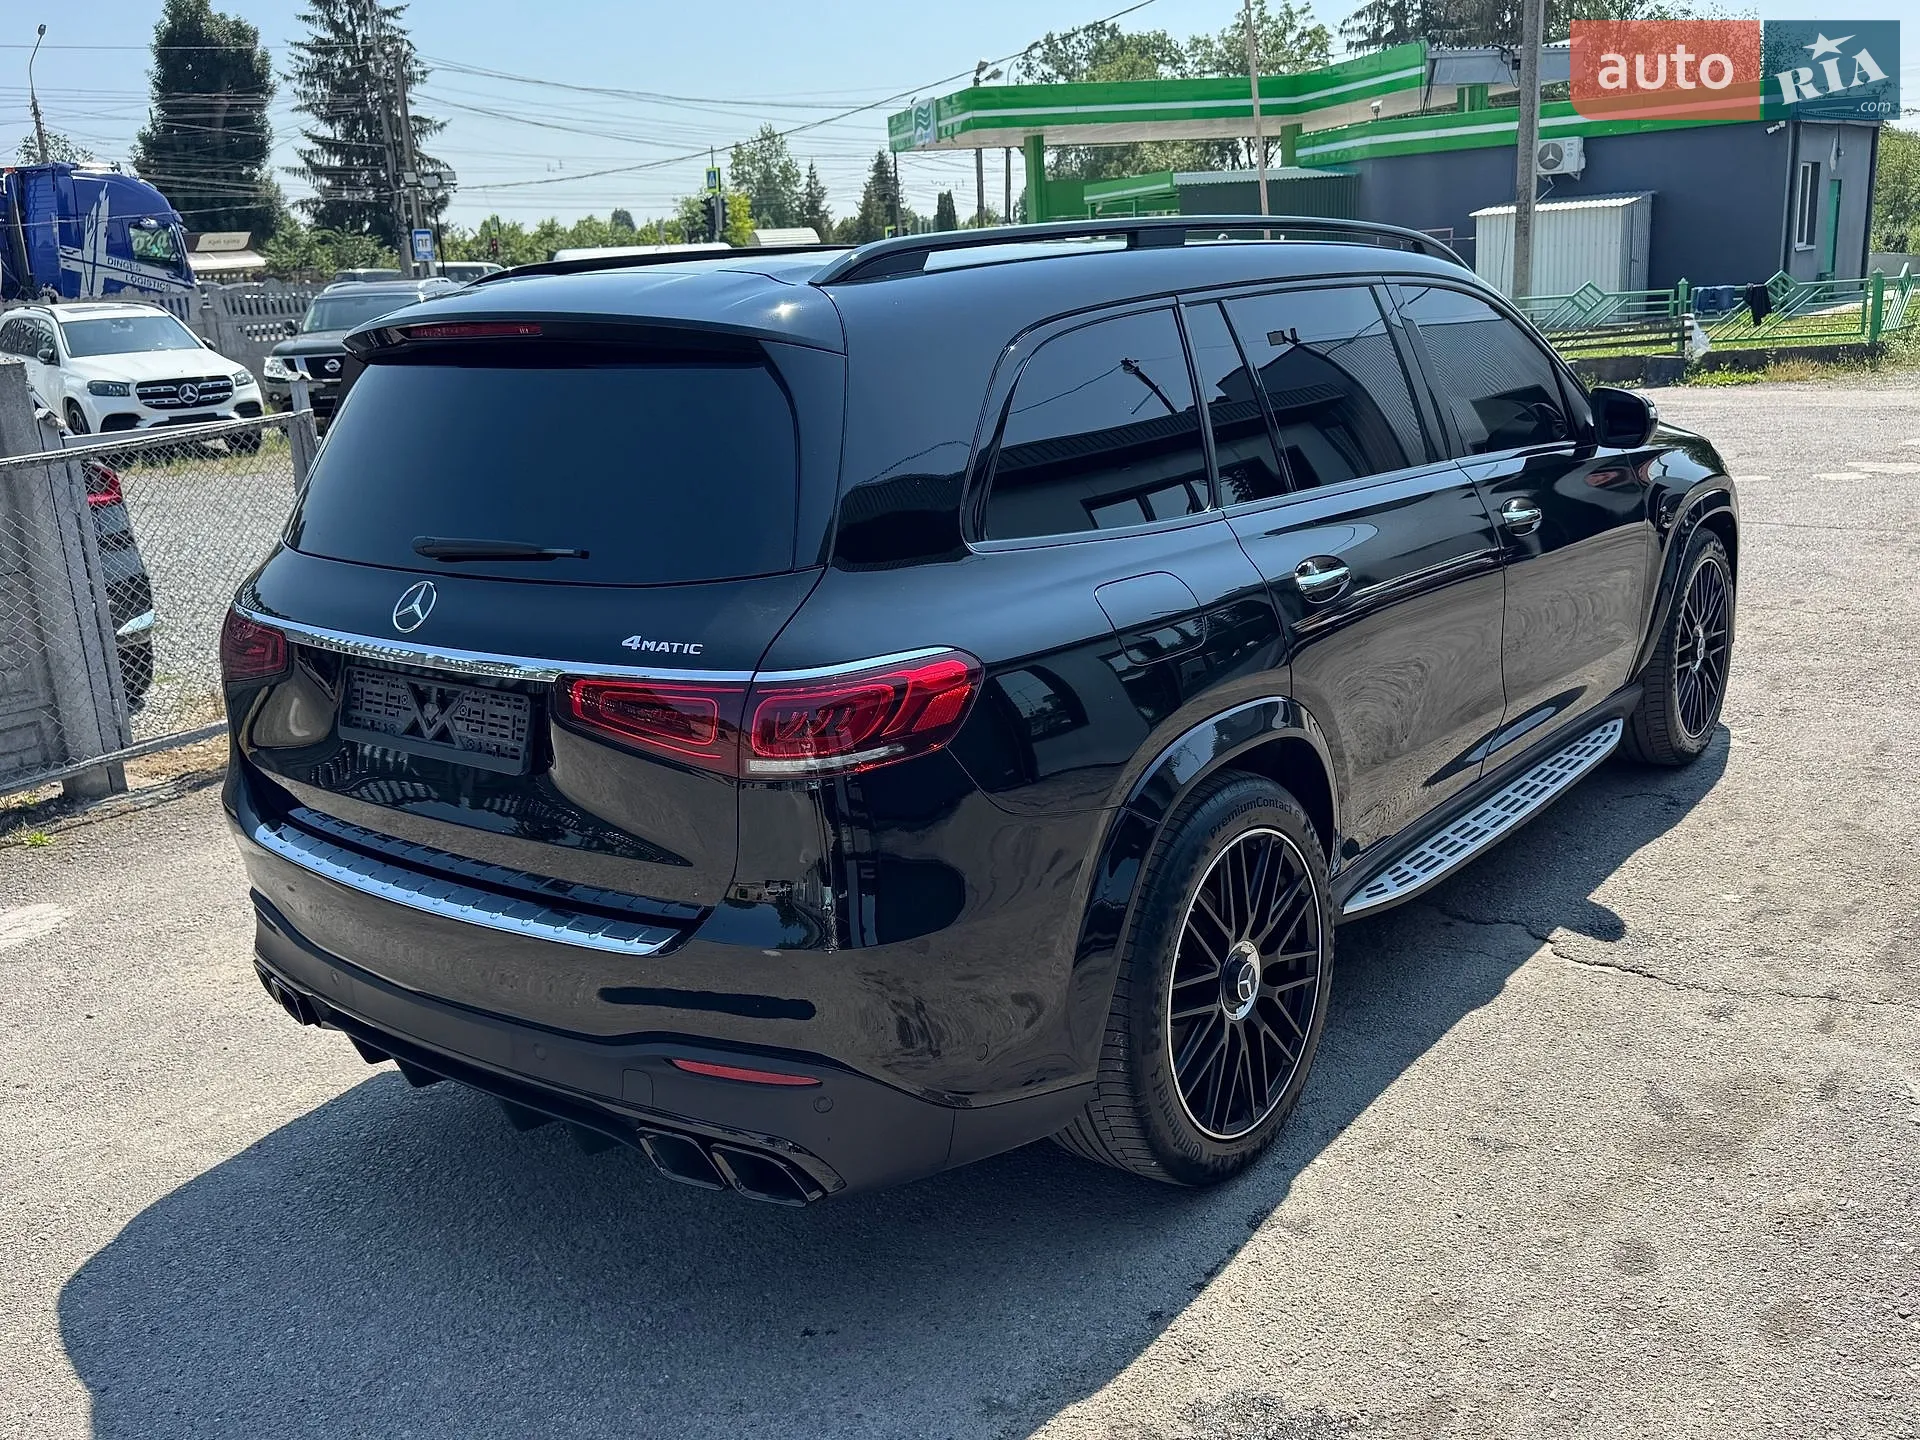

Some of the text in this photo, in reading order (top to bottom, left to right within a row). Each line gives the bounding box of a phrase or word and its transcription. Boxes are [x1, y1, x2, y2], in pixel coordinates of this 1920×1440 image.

[125, 273, 171, 291] LOGISTICS
[621, 635, 704, 655] 4MATIC
[1208, 796, 1293, 839] PremiumContact
